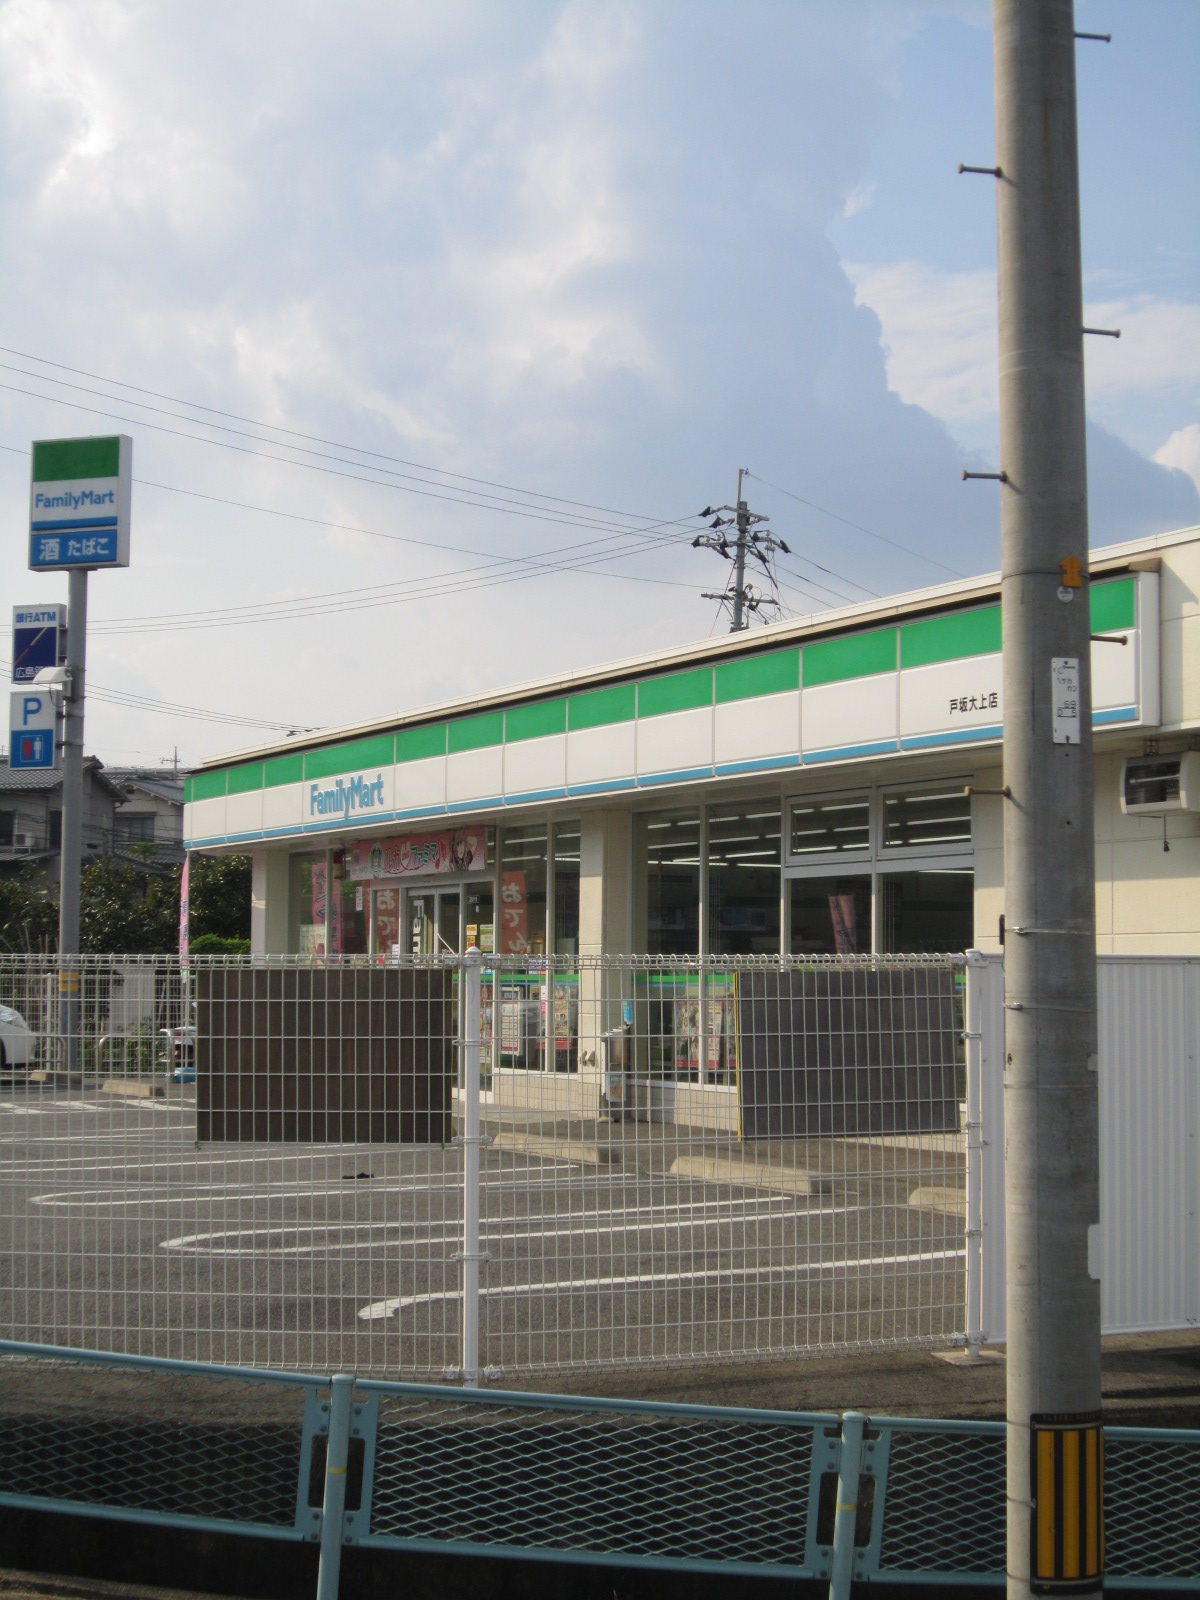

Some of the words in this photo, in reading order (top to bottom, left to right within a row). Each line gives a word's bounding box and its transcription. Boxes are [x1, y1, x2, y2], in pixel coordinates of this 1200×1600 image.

[35, 488, 115, 511] FamilyMart
[39, 538, 60, 561] 酒
[67, 536, 110, 558] たばこ
[15, 611, 56, 624] 銀行ATM
[23, 697, 42, 726] P
[949, 692, 998, 715] 戸坂大上店
[310, 773, 384, 821] FamilyMart
